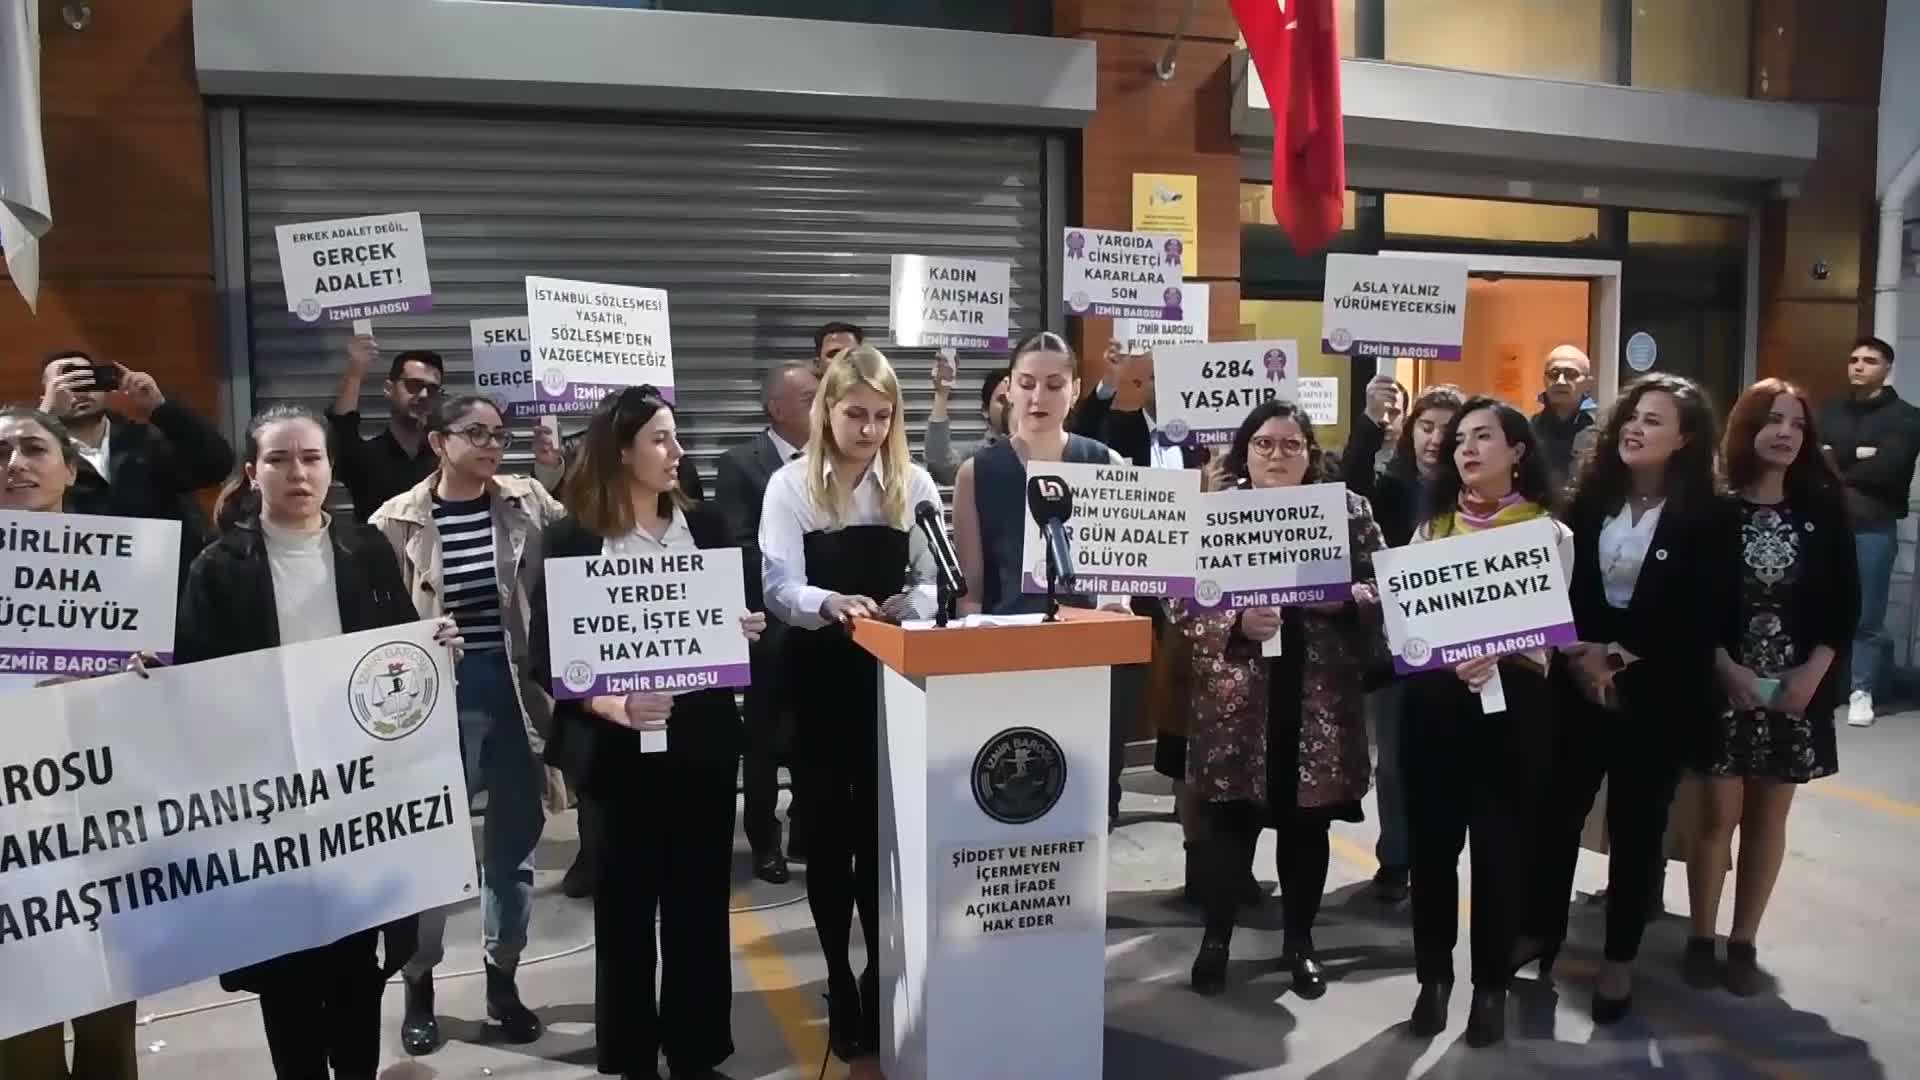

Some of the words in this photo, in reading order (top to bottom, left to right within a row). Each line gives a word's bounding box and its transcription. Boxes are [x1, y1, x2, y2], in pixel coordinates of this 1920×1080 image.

[292, 231, 330, 244] ERKEK
[332, 226, 371, 239] ADALET
[374, 220, 408, 234] DEĞİL,
[1097, 235, 1153, 249] YARGIDA
[313, 242, 396, 267] GERÇEK
[1088, 250, 1160, 267] CİNSİYETÇİ
[315, 268, 403, 294] ADALET!
[930, 267, 976, 282] KADIN
[1084, 268, 1165, 284] KARARLARA
[922, 288, 1004, 306] YANIŞMASI
[1112, 287, 1138, 300] SON
[1352, 281, 1388, 294] ASLA
[1392, 283, 1440, 296] YALNIZ
[536, 289, 592, 305] İSTANBUL
[595, 293, 662, 312] SÖZLEŞMESİ
[1333, 296, 1456, 314] YÜRÜMEYECEKSİN
[329, 307, 362, 321] İZMİR
[365, 302, 410, 317] BAROSU
[922, 308, 984, 325] YAŞATIR
[1094, 304, 1122, 316] İZMİR
[1124, 307, 1162, 318] BAROSU
[484, 329, 529, 347] ŞEKL
[551, 324, 652, 347] SÖZLEŞME'DEN
[1162, 324, 1194, 334] BAROSU
[540, 347, 667, 368] VAZGEÇMEYECEĞİZ
[1358, 342, 1391, 355] İZMİR
[1392, 346, 1439, 358] BAROSU
[1202, 360, 1254, 378] 6284
[478, 371, 533, 388] GERÇE
[574, 384, 605, 400] İZMİR
[516, 402, 547, 416] İZMİR
[550, 400, 594, 414] BAROSU
[1195, 430, 1228, 444] İZMİR
[1096, 469, 1139, 483] KADIN
[1071, 486, 1176, 503] NAYETLERİNDE
[1073, 504, 1098, 518] RİM
[1102, 506, 1186, 522] UYGULANAN
[1206, 505, 1324, 526] SUSMUYORUZ,
[1080, 523, 1116, 542] GÜN
[1121, 528, 1189, 545] ADALET
[1201, 526, 1333, 548] KORKMUYORUZ,
[585, 557, 654, 578] KADIN
[661, 554, 704, 574] HER
[1078, 546, 1148, 568] ÖLÜYOR
[1248, 546, 1342, 567] ETMİYORUZ
[14, 566, 102, 592] DAHA
[1388, 560, 1480, 598] ŞİDDETE
[1484, 546, 1550, 574] KARŞI
[606, 583, 687, 604] YERDE!
[1074, 576, 1108, 592] ZMİR
[1111, 580, 1167, 594] BAROSU
[1231, 593, 1268, 608] İZMİR
[1271, 589, 1325, 605] BAROSU
[1398, 574, 1552, 618] YANINIZDAYIZ
[573, 615, 637, 635] EVDE,
[643, 608, 691, 634] İŞTE
[696, 608, 724, 626] VE
[600, 638, 702, 662] HAYATTA
[1440, 642, 1484, 664] İZMİR
[1486, 632, 1546, 656] BAROSU
[0, 651, 48, 671] ZMİR
[606, 674, 650, 693] İZMİR
[654, 671, 719, 690] BAROSU
[0, 746, 114, 806] ROSU
[158, 768, 330, 837] DANIŞMA
[336, 755, 376, 795] VE
[952, 848, 1004, 868] ŞİDDET
[1008, 846, 1028, 858] VE
[1031, 840, 1085, 858] NEFRET
[0, 832, 310, 945] ARAŞTIRMALARI
[319, 784, 454, 862] MERKEZİ
[976, 860, 1061, 882] İÇERMEYEN
[981, 882, 1010, 898] HER
[1014, 878, 1056, 894] İFADE
[966, 894, 1071, 918] AÇIKLANMAYI
[982, 918, 1014, 932] HAK
[1018, 914, 1054, 929] EDER
